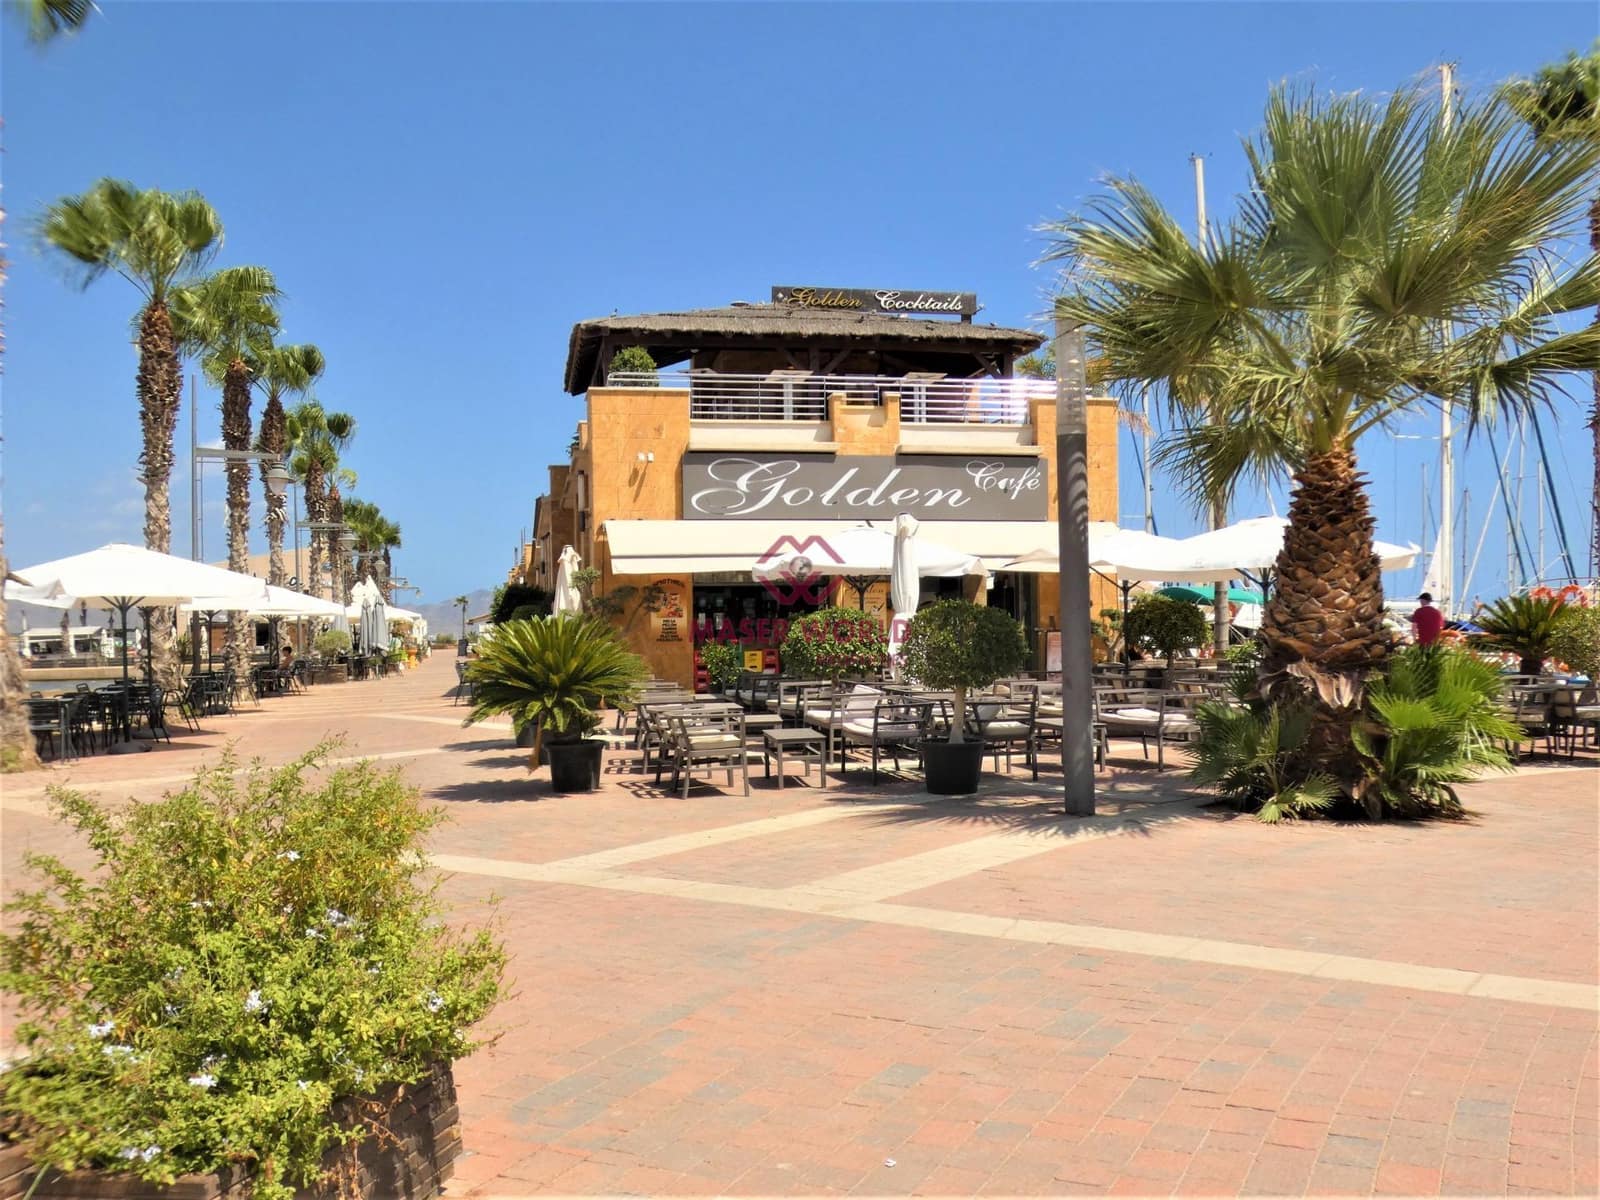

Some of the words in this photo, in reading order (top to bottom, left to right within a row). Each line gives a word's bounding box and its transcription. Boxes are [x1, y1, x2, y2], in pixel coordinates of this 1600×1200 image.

[788, 287, 863, 309] Golden
[875, 290, 963, 311] Cocktails
[691, 457, 971, 515] Golden
[966, 460, 1041, 499] Café
